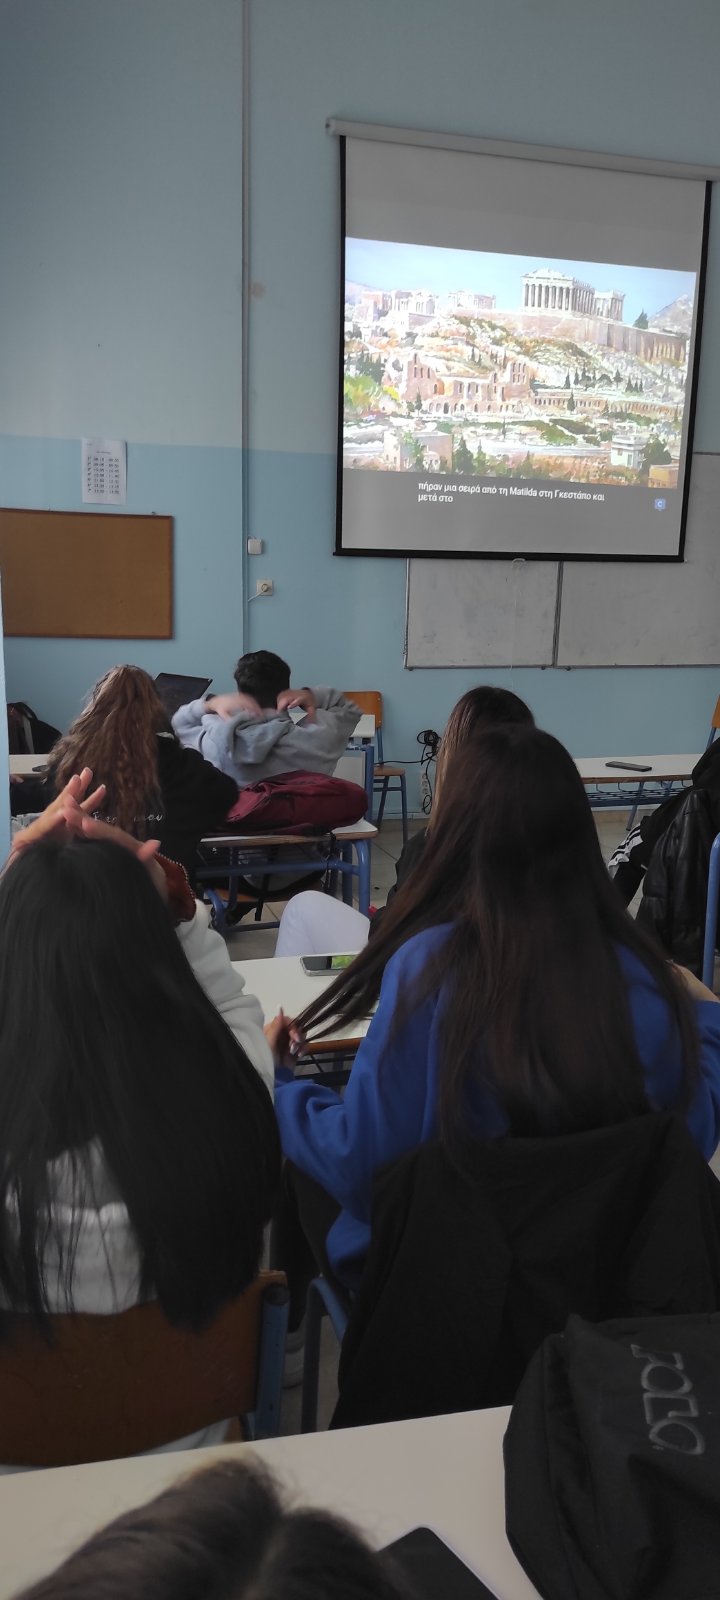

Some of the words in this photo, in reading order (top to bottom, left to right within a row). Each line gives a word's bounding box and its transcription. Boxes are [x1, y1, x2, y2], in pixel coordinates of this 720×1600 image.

[418, 481, 442, 492] πήραν
[443, 484, 457, 493] μια
[458, 484, 481, 494] σειρά
[481, 485, 497, 494] από
[499, 487, 508, 496] τη
[509, 486, 537, 497] Matilda
[538, 490, 553, 499] στη
[554, 489, 592, 500] Γκεστάπο
[592, 493, 605, 501] και
[418, 493, 437, 502] μετά
[438, 494, 454, 502] στο
